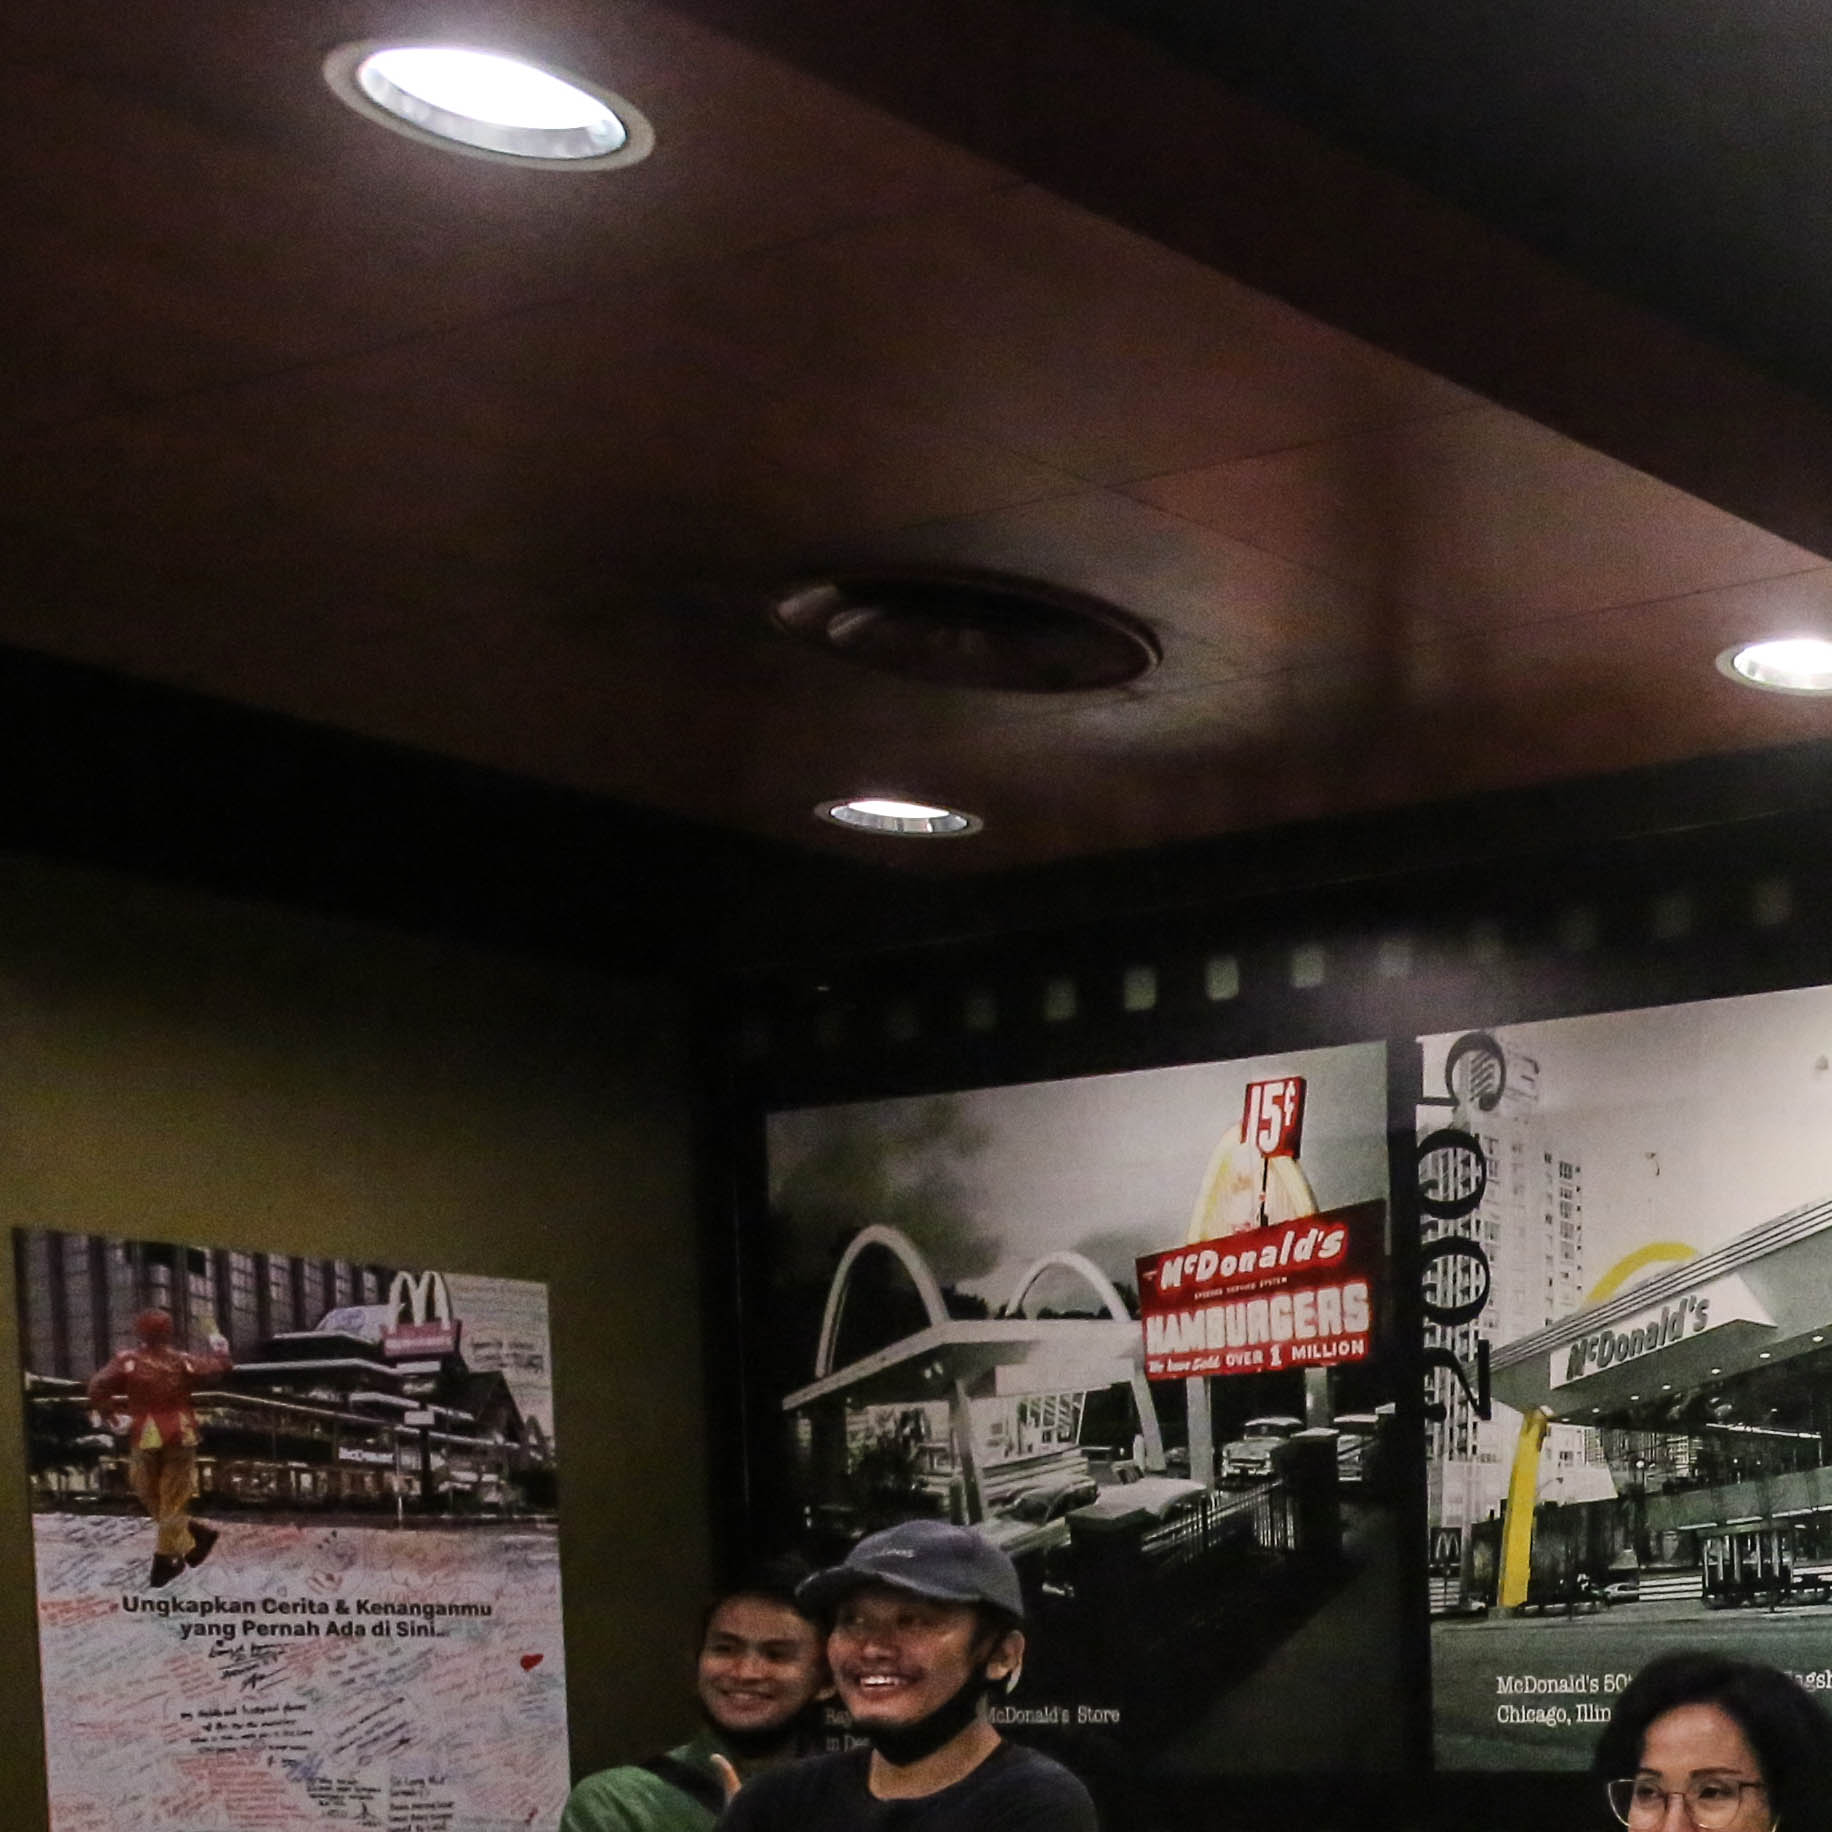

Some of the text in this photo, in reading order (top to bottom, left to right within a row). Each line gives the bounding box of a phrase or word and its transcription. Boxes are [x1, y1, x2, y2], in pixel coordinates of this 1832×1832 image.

[1160, 1227, 1346, 1291] McDonald's
[1145, 1283, 1370, 1356] HAMBURGERS
[1566, 1296, 1710, 1381] McDonald's
[1225, 1351, 1264, 1367] OVER
[1270, 1344, 1283, 1367] 1
[1291, 1340, 1365, 1361] MILLION
[122, 1596, 492, 1620] Ungkapkan Cerita & Kenanganmu
[179, 1621, 236, 1641] yang
[242, 1620, 320, 1637] Pernah
[326, 1620, 366, 1637] Ada
[371, 1620, 391, 1637] di
[1496, 1674, 1599, 1694] McDonald's
[1078, 1705, 1121, 1724] Store
[1497, 1704, 1572, 1727] Chicago,
